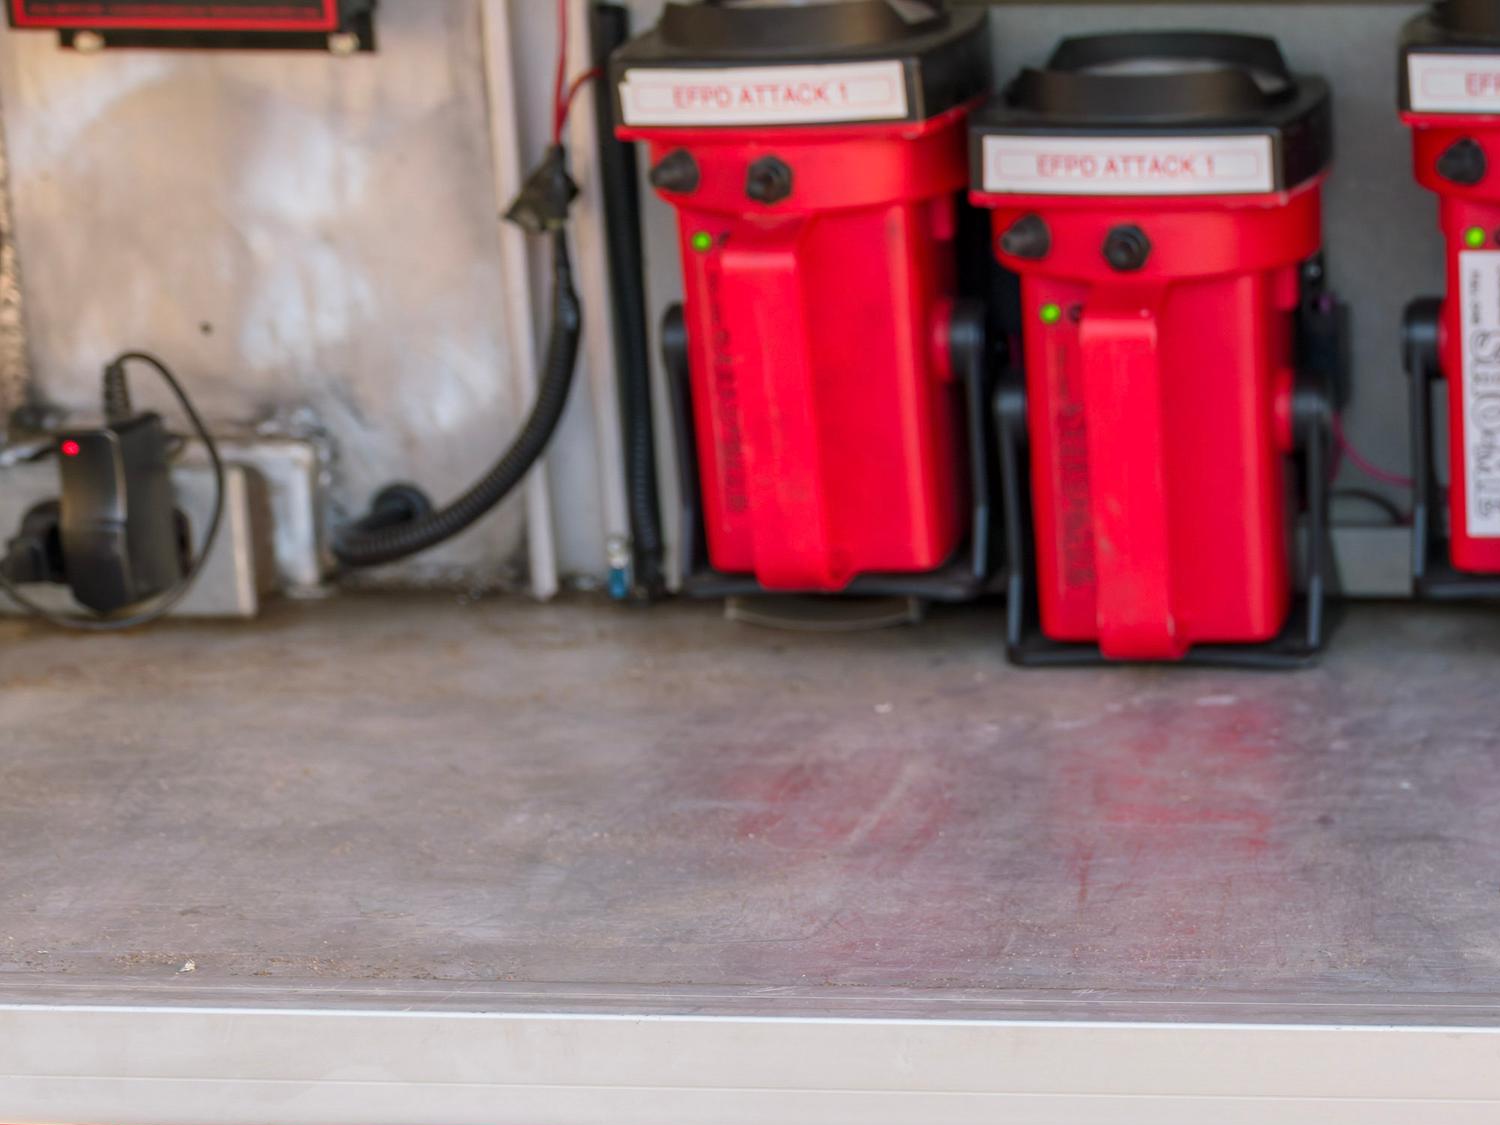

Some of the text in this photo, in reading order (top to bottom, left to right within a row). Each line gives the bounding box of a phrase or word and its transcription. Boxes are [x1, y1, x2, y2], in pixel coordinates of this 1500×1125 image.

[672, 82, 849, 109] EFPD ATTACK 1
[1035, 154, 1216, 177] EFPD ATTACK 1
